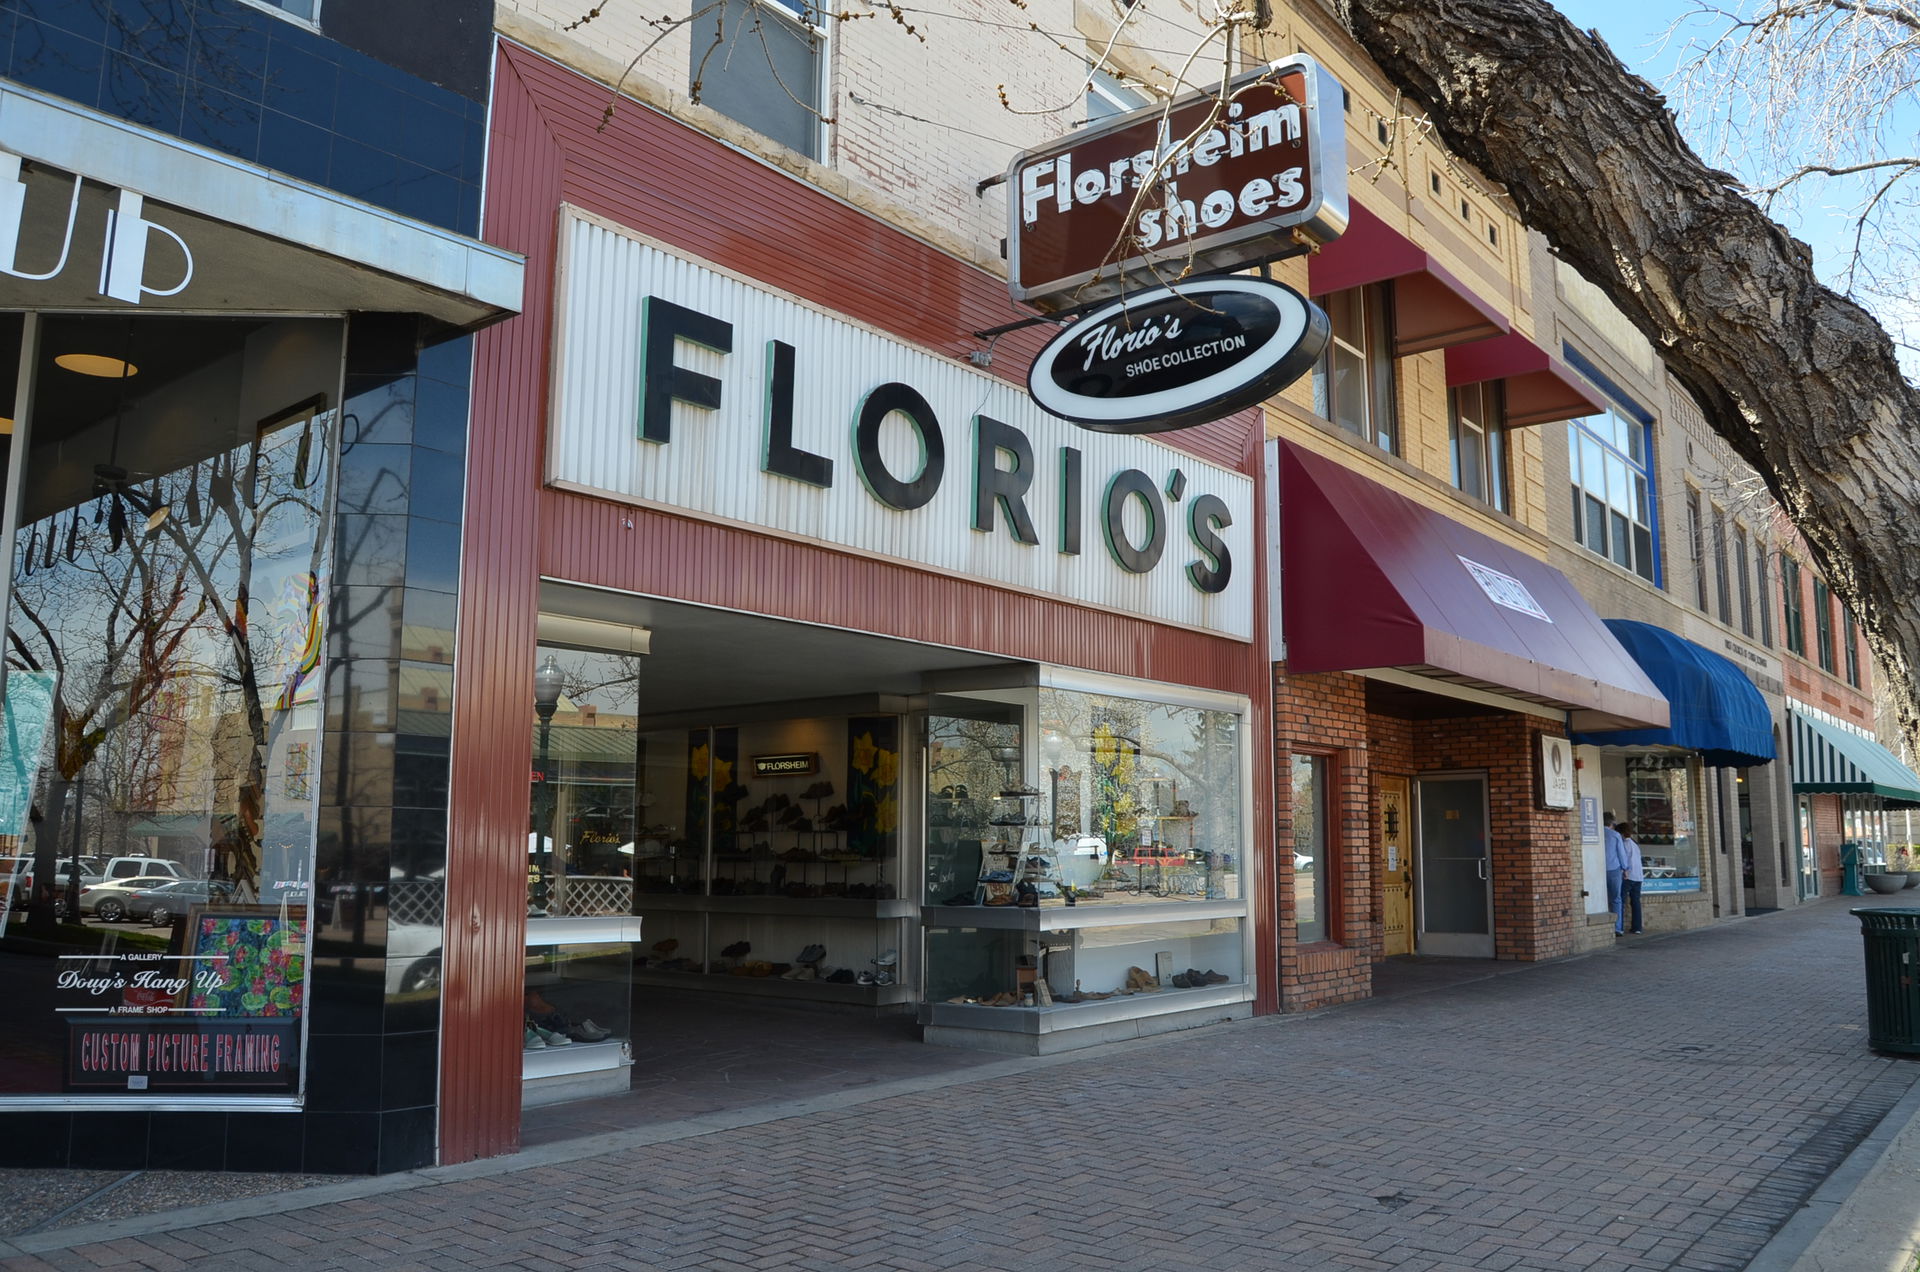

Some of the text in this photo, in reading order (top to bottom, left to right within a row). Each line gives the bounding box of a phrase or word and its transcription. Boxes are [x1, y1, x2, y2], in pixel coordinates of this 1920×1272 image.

[1022, 103, 1301, 224] Florsheim
[0, 152, 193, 304] UP
[1136, 167, 1304, 248] shoes
[1080, 314, 1182, 371] Florio's
[1126, 335, 1246, 377] SHOE COLLECTION
[637, 295, 1232, 594] FLORIO'S
[766, 760, 809, 771] FLORSHEIM
[120, 953, 162, 961] A GALLERY
[57, 970, 227, 995] Doug's Hang Up
[81, 1032, 281, 1072] CUSTOM PICTURE FRAMING
